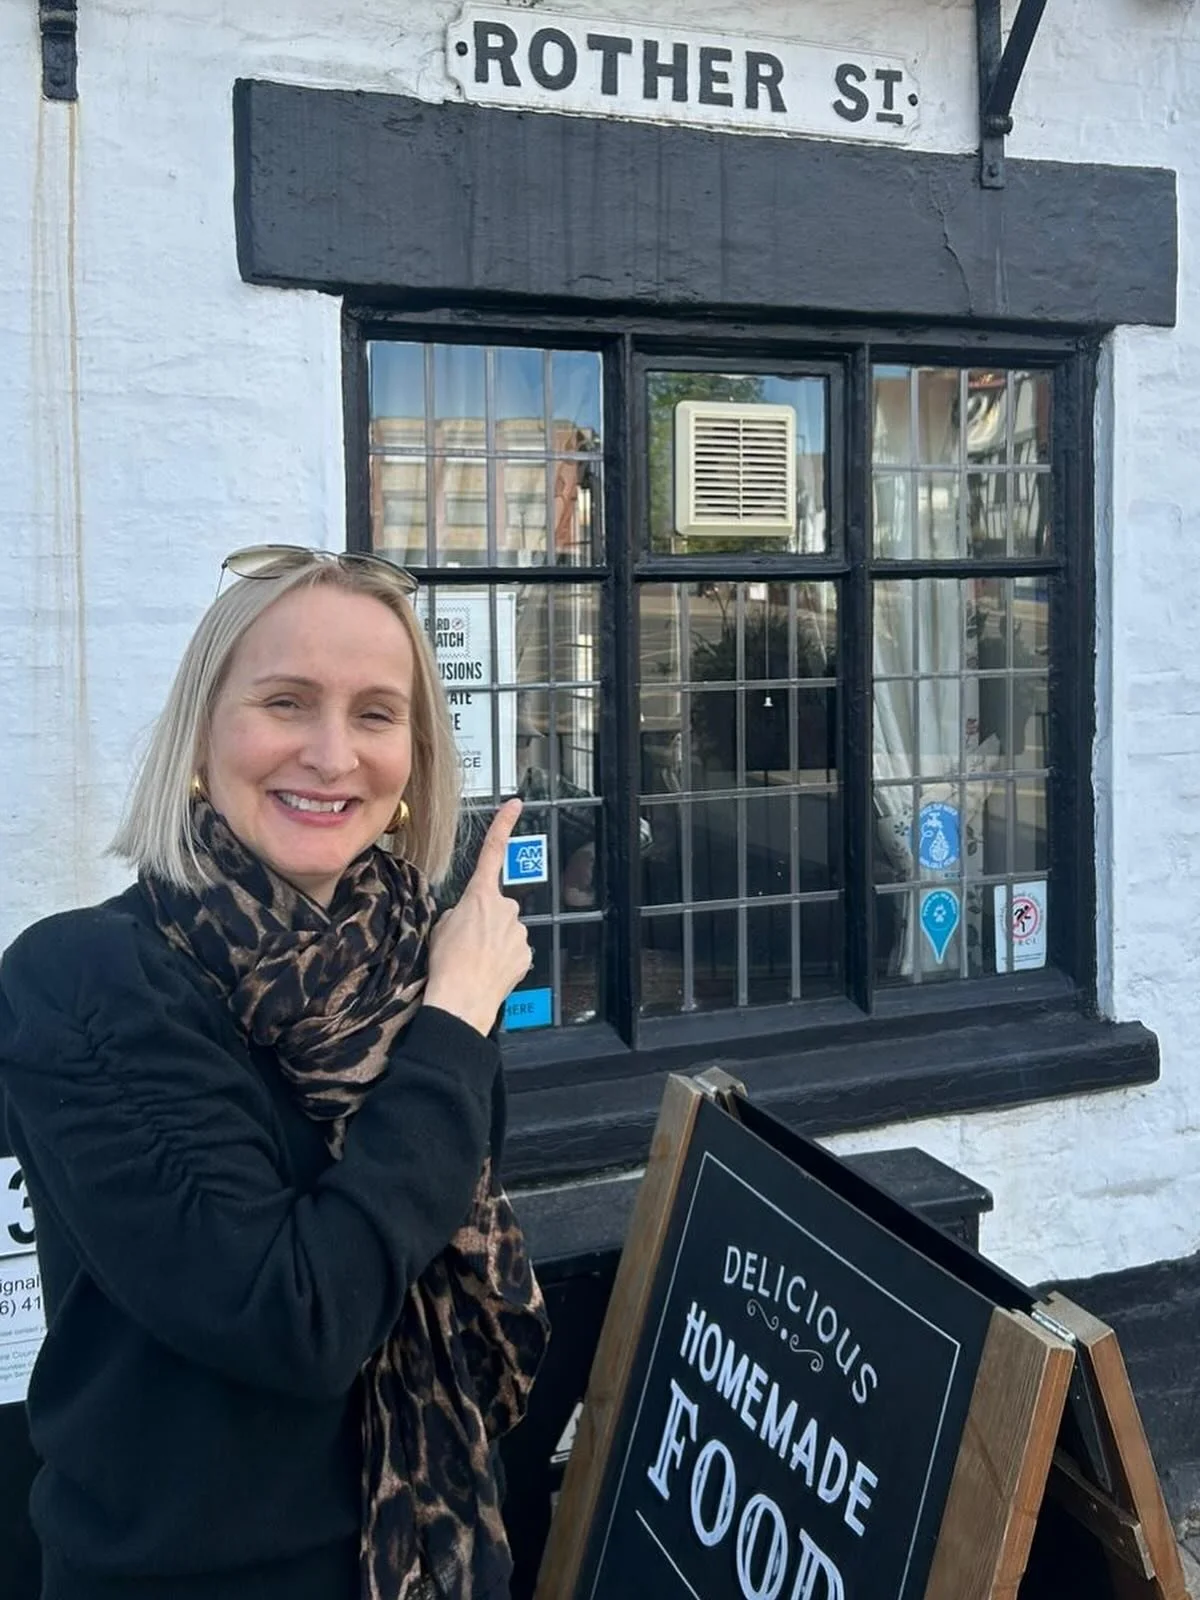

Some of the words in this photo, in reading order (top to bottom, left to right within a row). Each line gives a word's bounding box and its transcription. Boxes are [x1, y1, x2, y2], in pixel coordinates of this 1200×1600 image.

[474, 20, 787, 113] ROTHER
[424, 617, 450, 631] BRD
[436, 631, 464, 648] ATCH
[438, 661, 482, 680] USIONS
[518, 846, 543, 860] AM
[521, 859, 543, 871] EX
[0, 1273, 40, 1297] ignal
[722, 1245, 878, 1405] DELICIOUS
[679, 1301, 879, 1537] HOMEMADE
